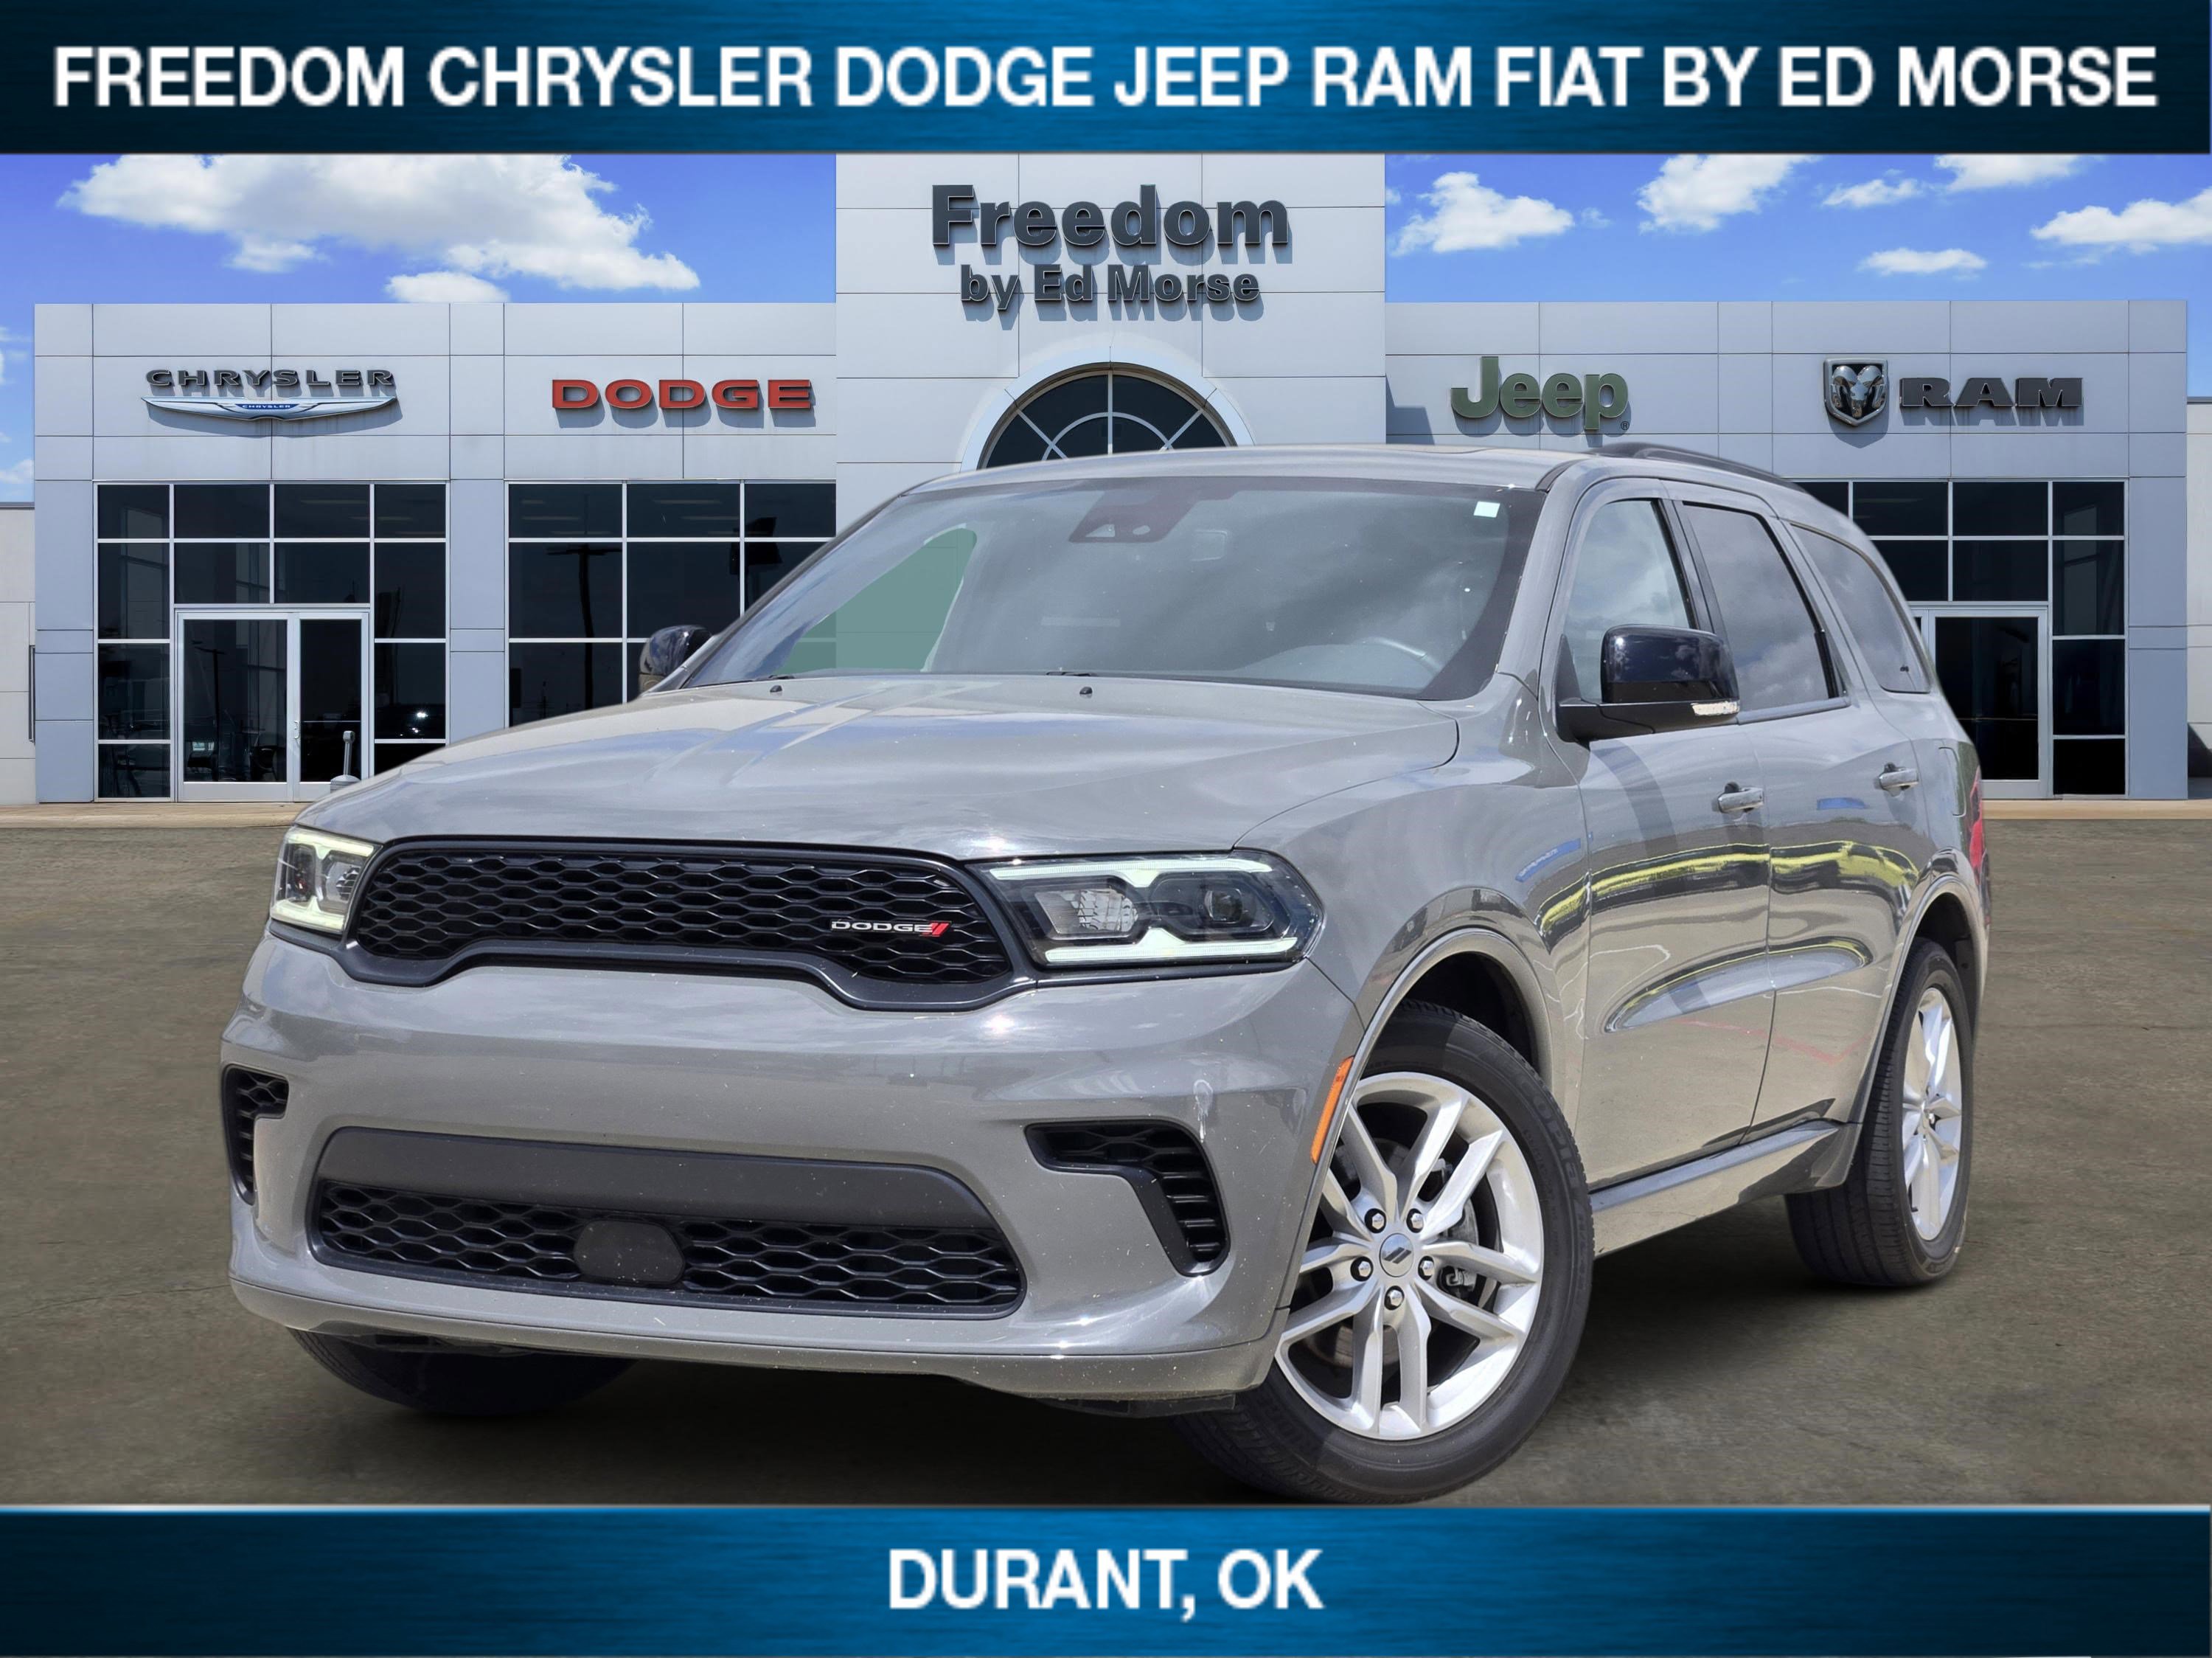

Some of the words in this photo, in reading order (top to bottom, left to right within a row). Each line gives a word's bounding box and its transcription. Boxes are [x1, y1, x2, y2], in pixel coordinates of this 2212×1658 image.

[932, 184, 1289, 246] Freedom
[961, 264, 1018, 311] by
[1034, 264, 1093, 302] Ed
[1107, 264, 1260, 302] Morse
[146, 370, 396, 386] CHRYSLER
[1451, 356, 1629, 430] Jeep
[1899, 378, 2084, 407] RAM
[552, 379, 811, 409] DODGE
[831, 921, 933, 933] DODGE
